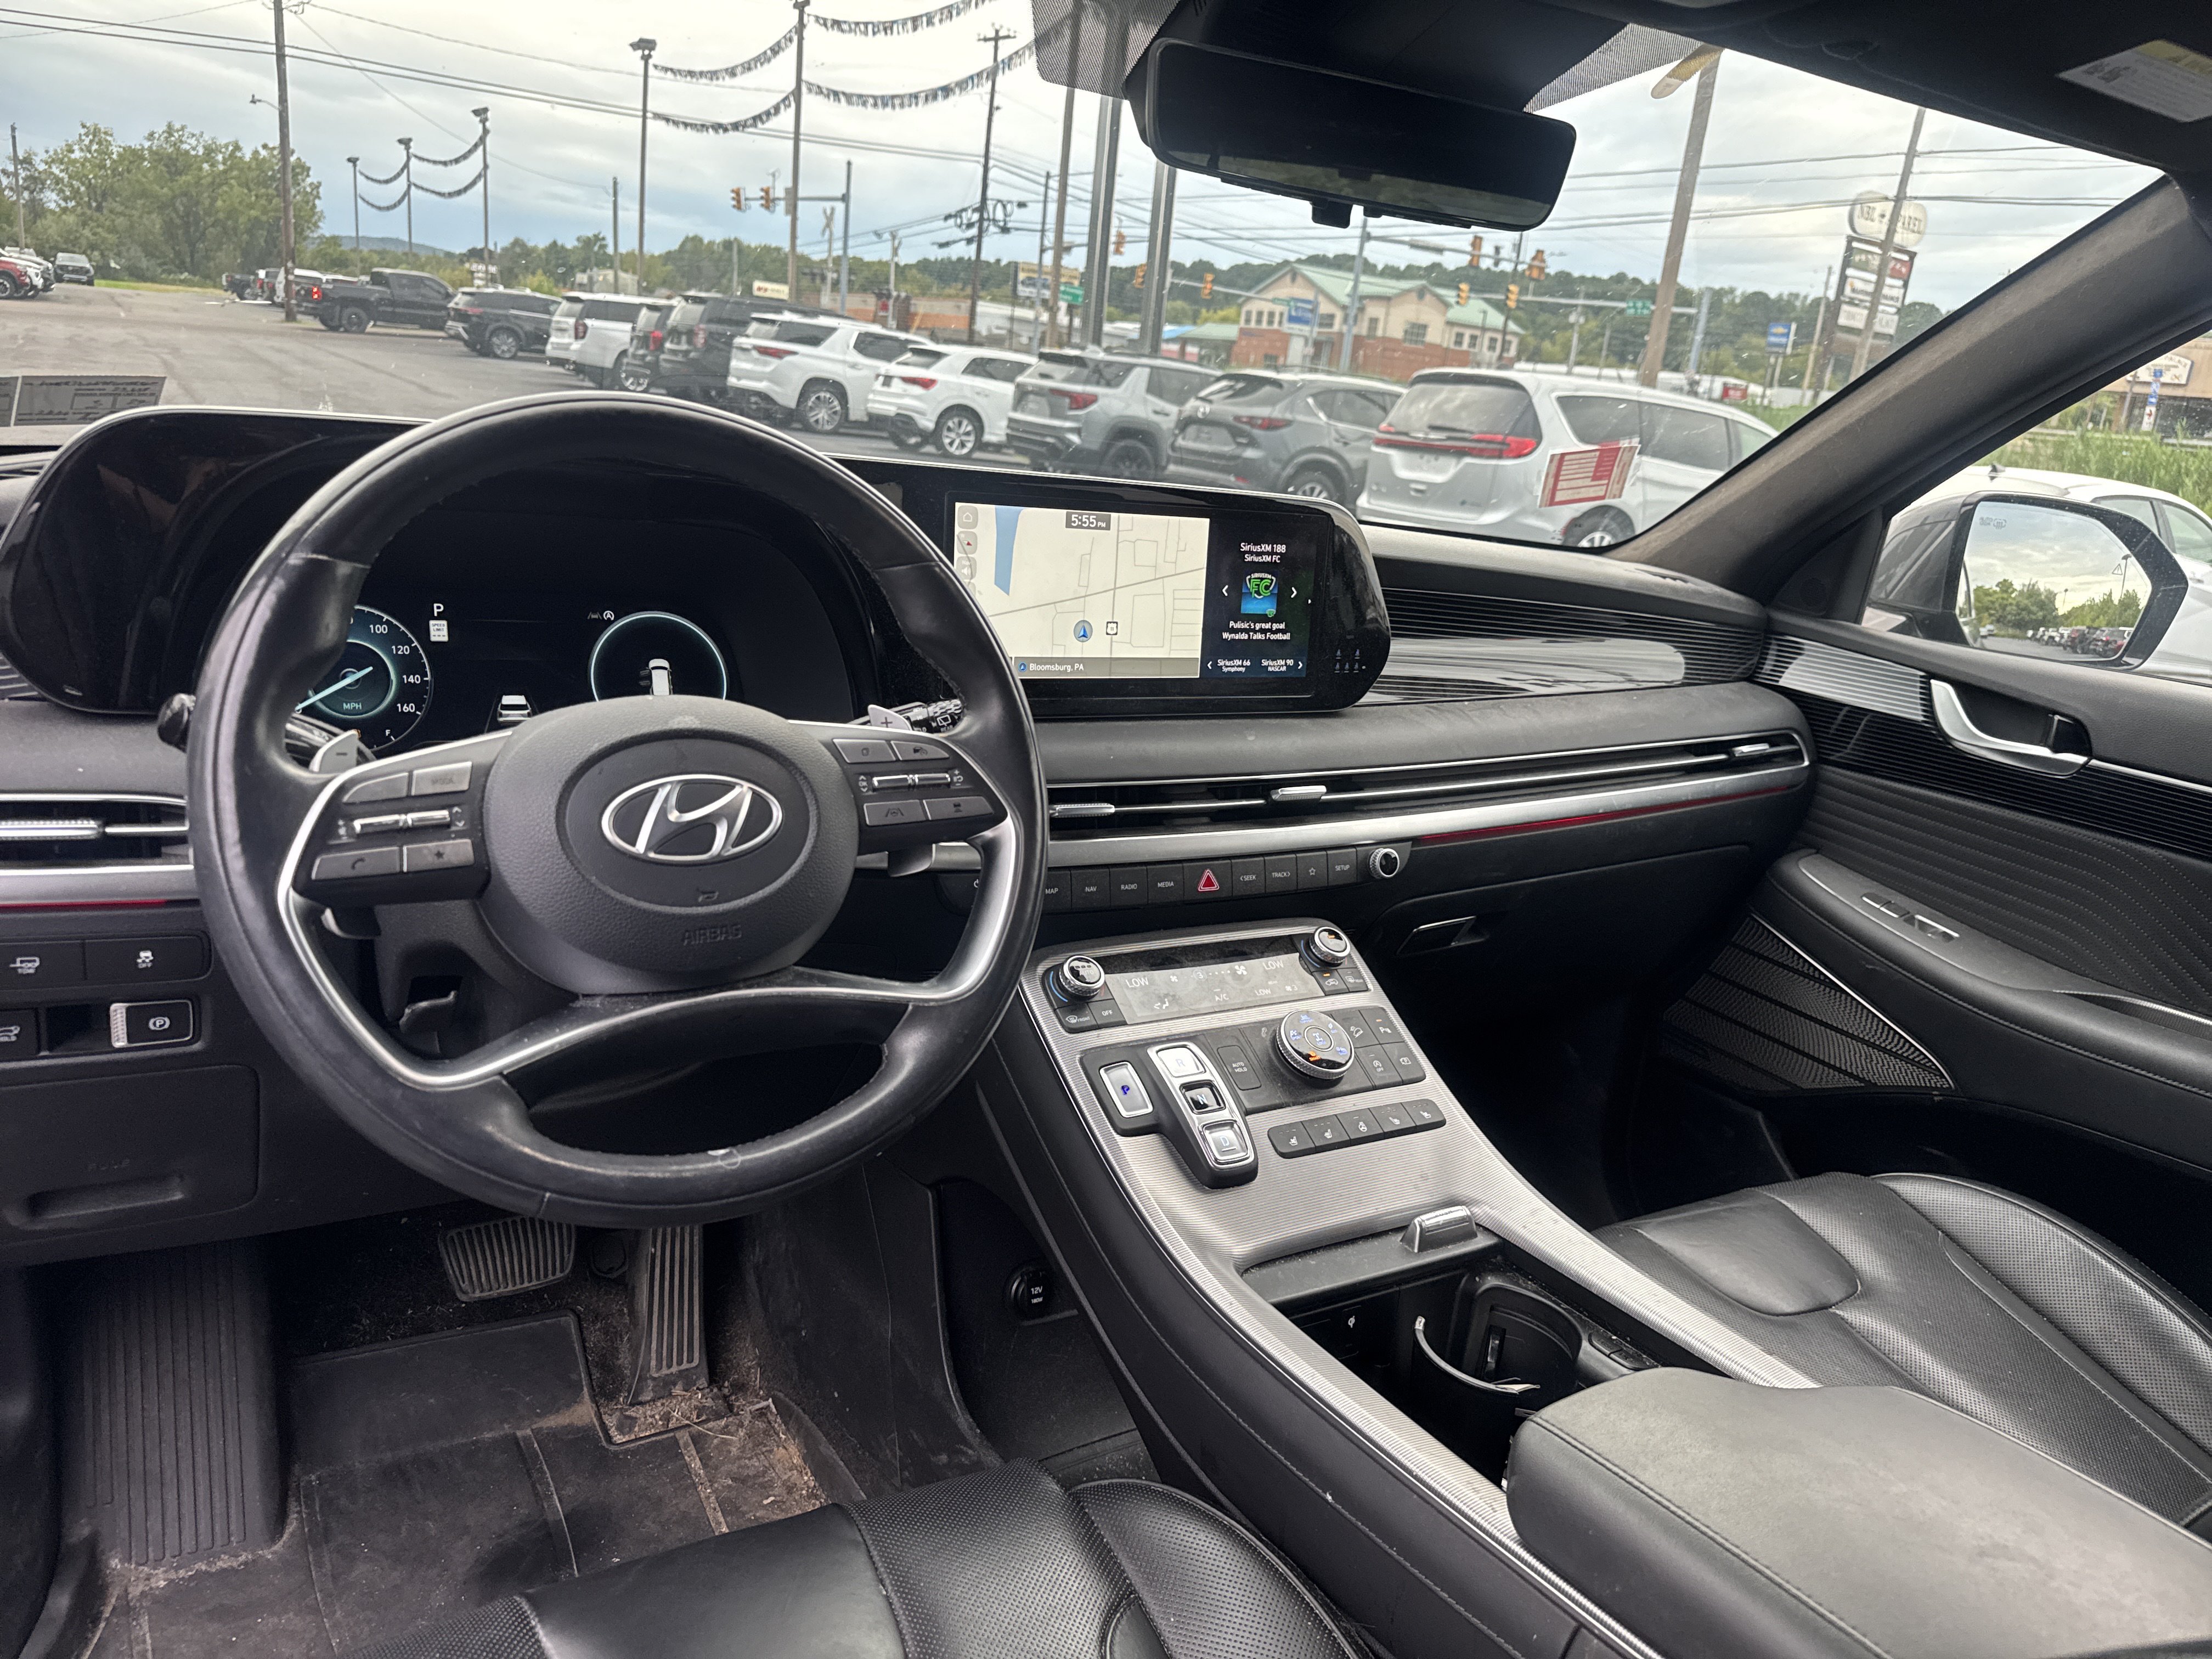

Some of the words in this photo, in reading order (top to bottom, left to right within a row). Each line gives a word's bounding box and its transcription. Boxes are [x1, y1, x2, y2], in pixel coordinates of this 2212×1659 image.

[1071, 514, 1097, 527] 5:55
[1240, 542, 1272, 552] SiriusXM
[1273, 544, 1286, 553] 188
[1244, 554, 1271, 562] SiriusXM
[1272, 555, 1280, 563] FC
[1250, 579, 1272, 598] FC
[433, 603, 444, 617] P
[369, 624, 388, 634] 100
[1229, 620, 1255, 629] Pulisic's
[1255, 622, 1271, 630] great
[1272, 622, 1285, 630] goal
[1222, 631, 1248, 641] Wynalda
[391, 645, 410, 654] 120
[1029, 663, 1073, 673] Bloomsburg,
[402, 674, 421, 684] 140
[397, 703, 415, 713] 160
[683, 924, 742, 946] AIRBAG
[1263, 960, 1284, 970] LOW
[1125, 977, 1149, 988] LOW
[1175, 1058, 1186, 1068] R
[1121, 1085, 1130, 1096] P
[1197, 1093, 1208, 1105] N
[1219, 1135, 1231, 1147] D
[1031, 1285, 1043, 1295] 12V
